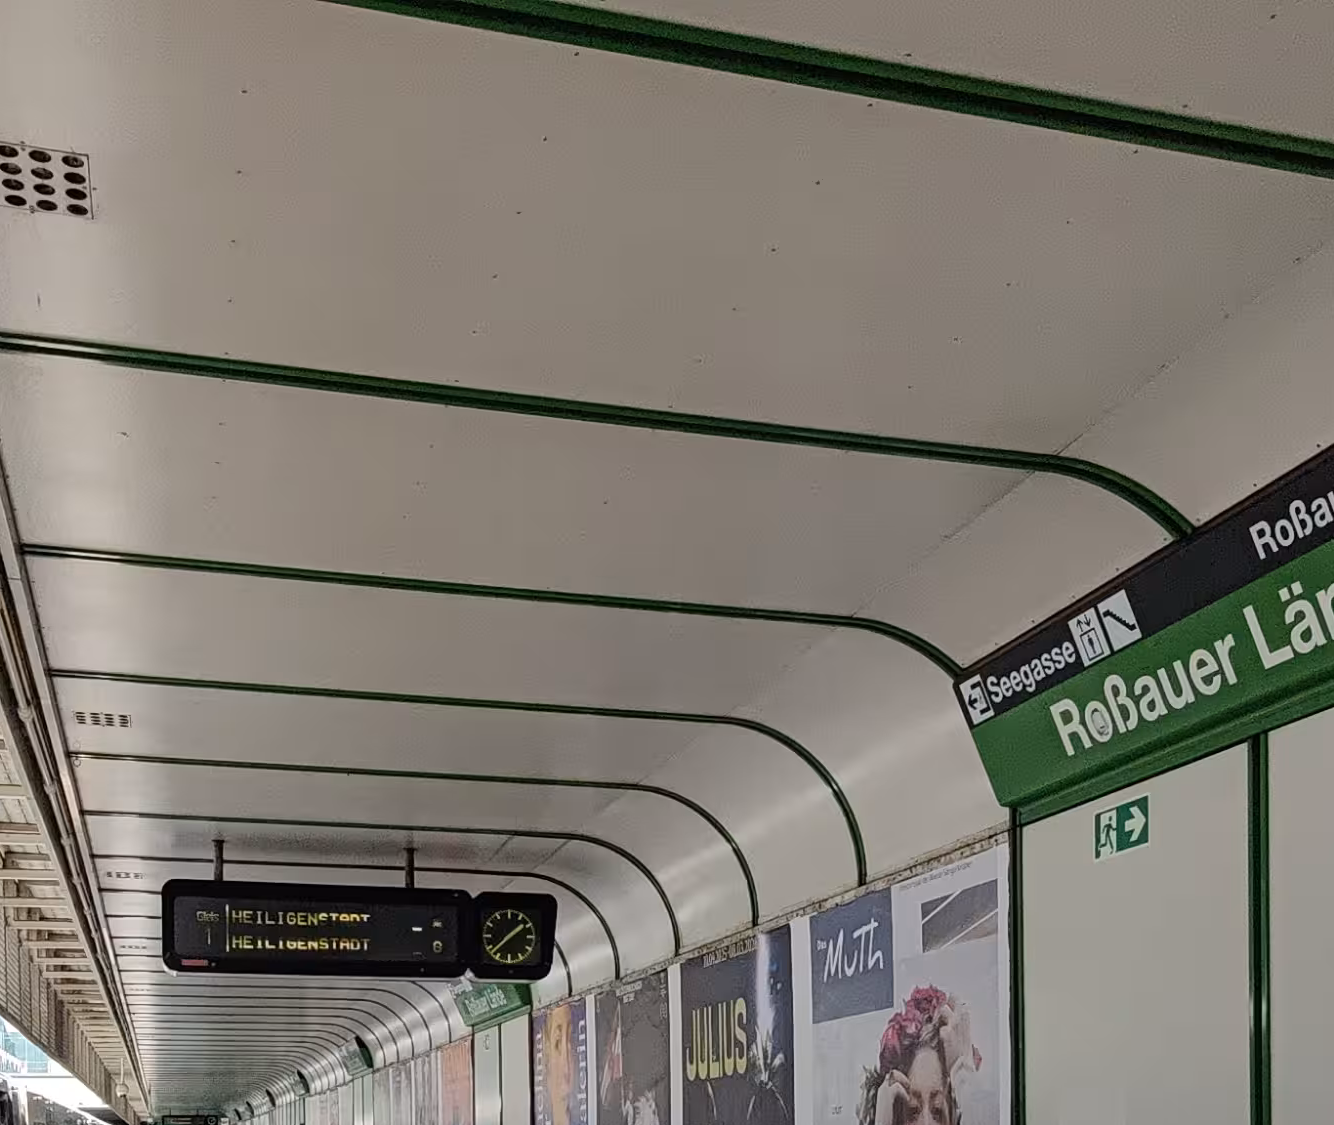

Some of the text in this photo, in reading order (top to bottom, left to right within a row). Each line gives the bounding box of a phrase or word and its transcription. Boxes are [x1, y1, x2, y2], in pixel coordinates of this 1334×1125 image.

[986, 640, 1077, 704] Seegasse
[1049, 632, 1238, 757] Roßauer
[231, 938, 371, 951] HEILIGENSTADT
[686, 997, 748, 1082] JULIUS
